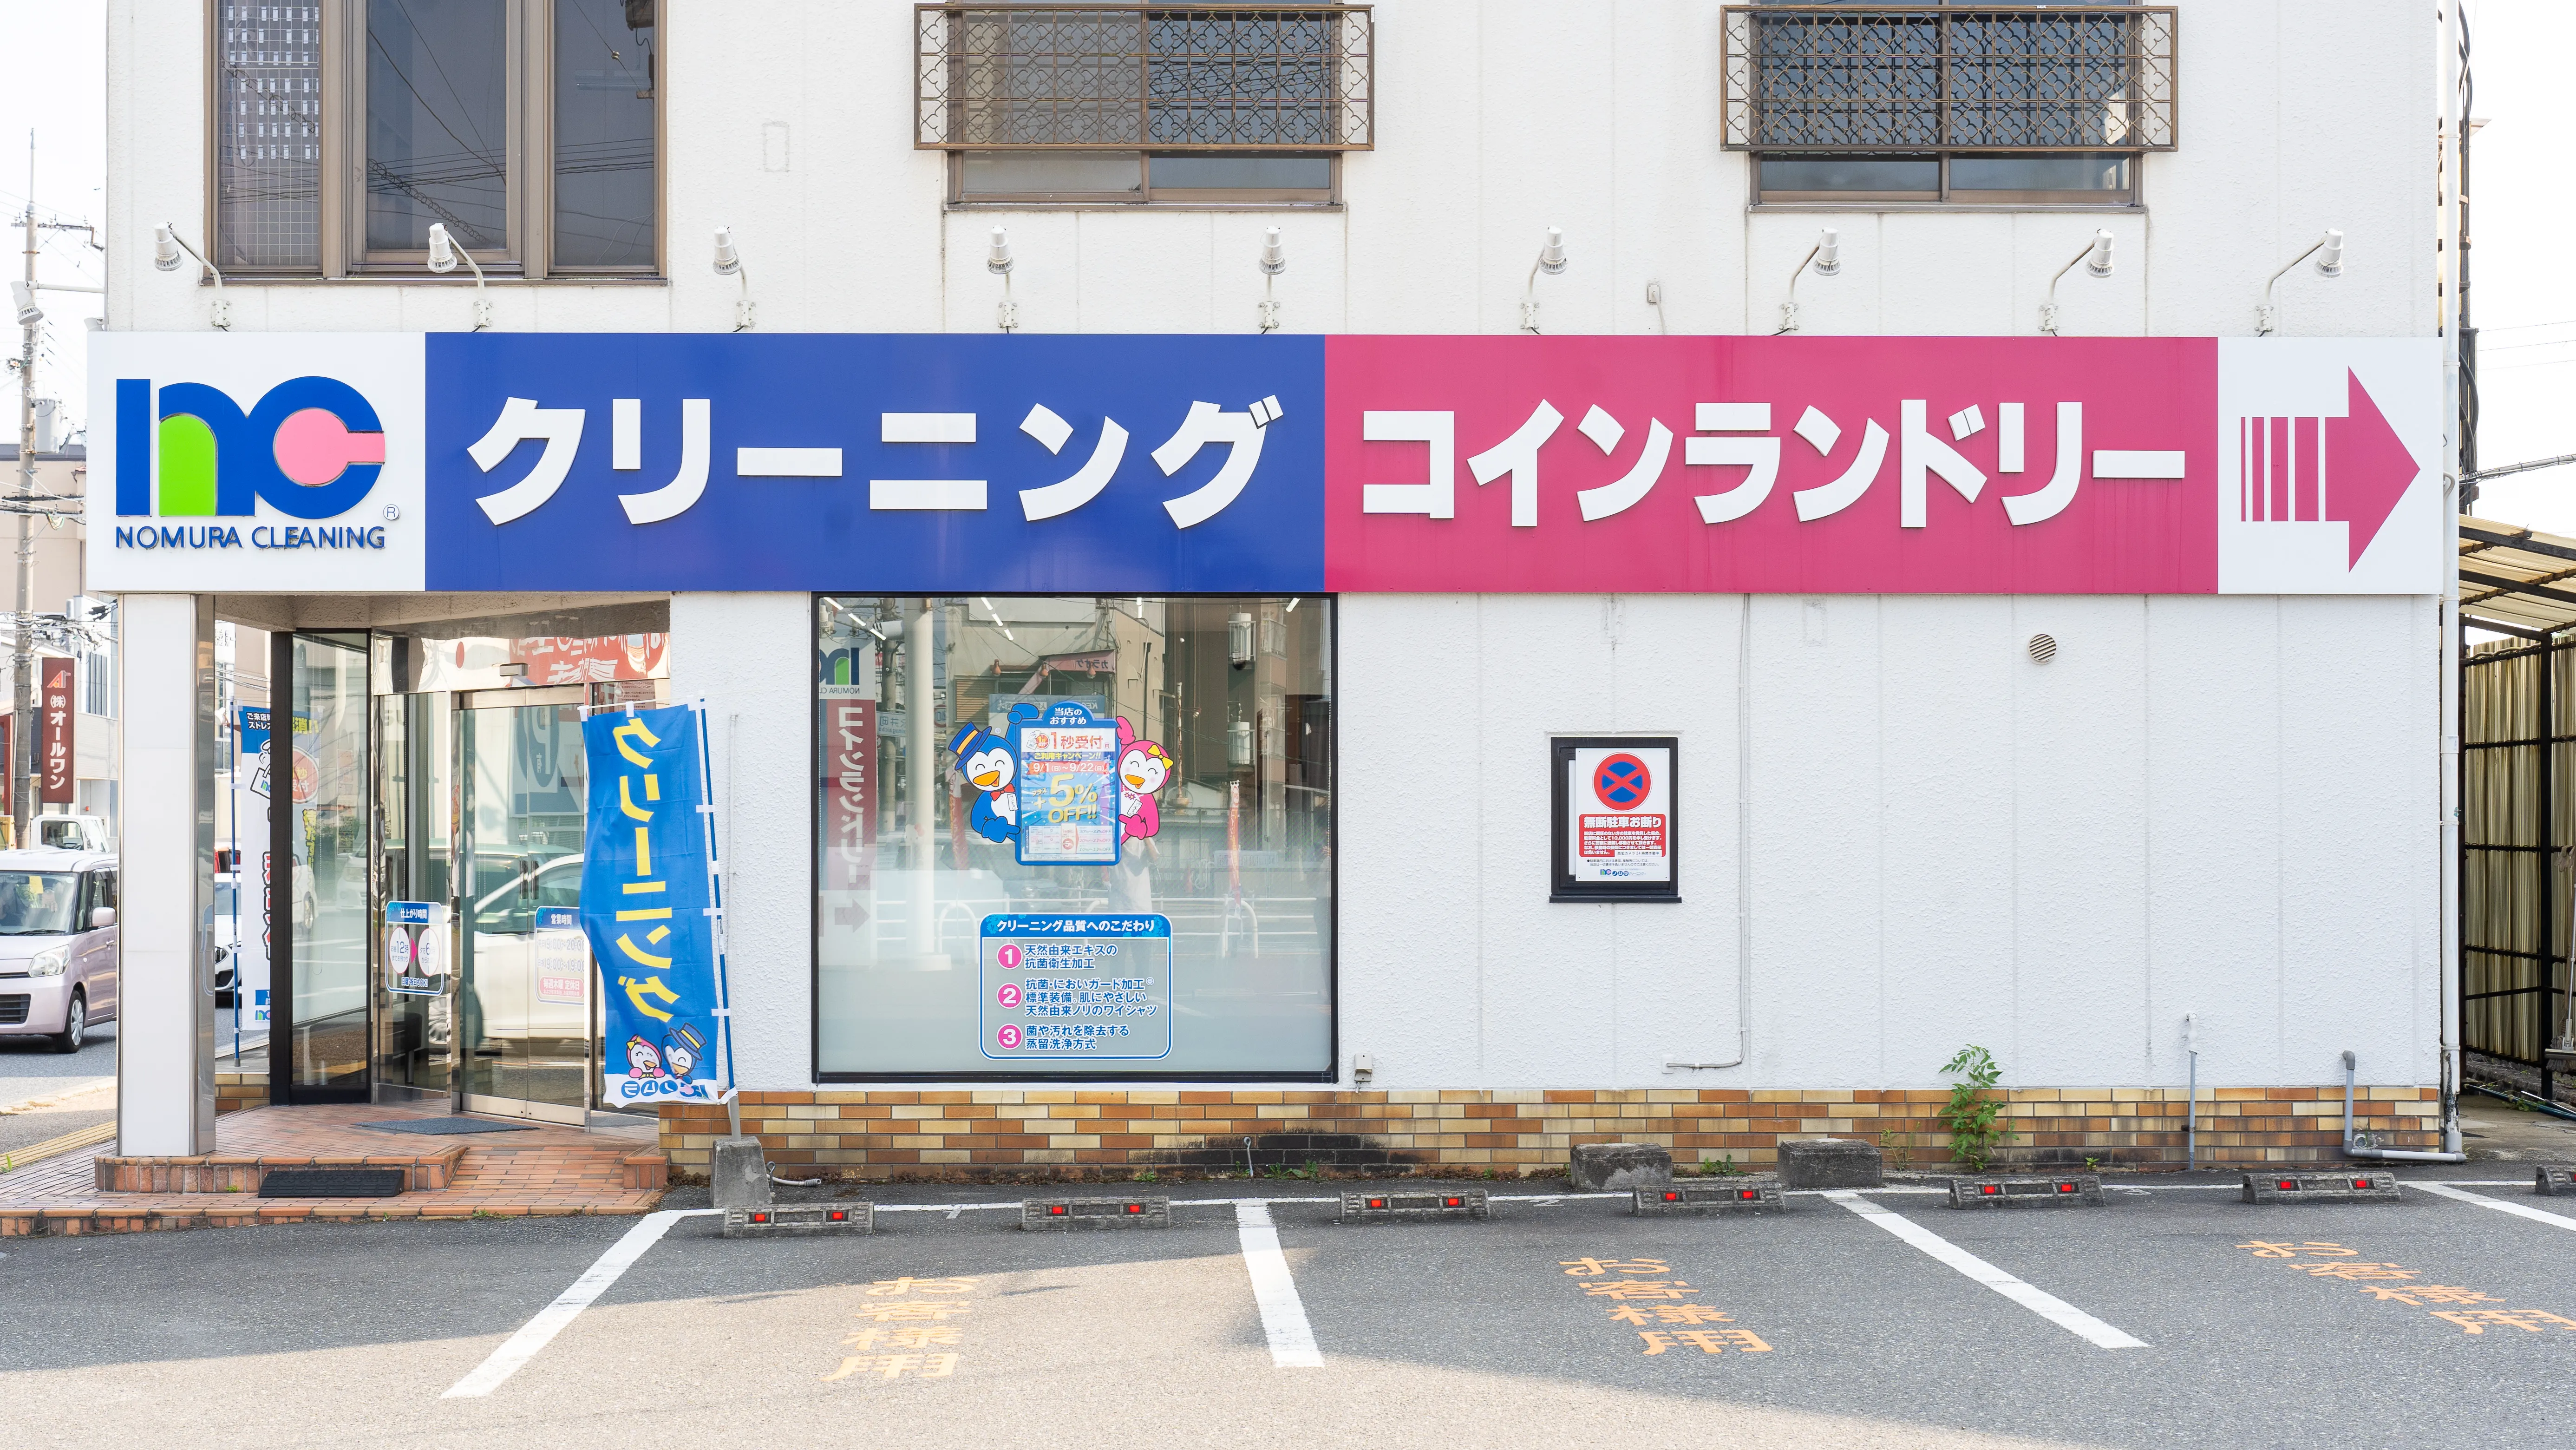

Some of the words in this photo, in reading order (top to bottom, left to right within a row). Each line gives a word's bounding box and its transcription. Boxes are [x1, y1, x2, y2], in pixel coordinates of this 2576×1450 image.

[467, 395, 1283, 529] クリーニング
[1363, 398, 2185, 528] コインランドリー
[116, 526, 242, 549] NOMURA
[251, 526, 386, 549] CLEANING
[1054, 708, 1082, 716] 当店の
[1051, 732, 1103, 749] 1秒受付
[1048, 804, 1097, 823] OFF!!
[1584, 816, 1661, 828] 無断駐車お断り
[400, 908, 427, 919] 仕上がり時間
[551, 914, 572, 925] 営業時間
[997, 920, 1154, 932] クリーニング品質へのこだわり
[1005, 949, 1013, 964] 1
[1025, 945, 1118, 956] 天然由来エキスの
[1025, 958, 1094, 969] 抗菌衛生加工
[1003, 988, 1016, 1004] 2
[1026, 992, 1146, 1003] 標準装備。肌にやさしい
[1025, 1005, 1157, 1016] 天然由来ノリのワイシャツ
[1003, 1029, 1016, 1044] 3
[1026, 1025, 1129, 1036] 菌や汚れを除去する
[1026, 1039, 1096, 1049] 蒸留洗浄方式
[1560, 1258, 1772, 1355] お客様用
[822, 1276, 980, 1382] お客様用
